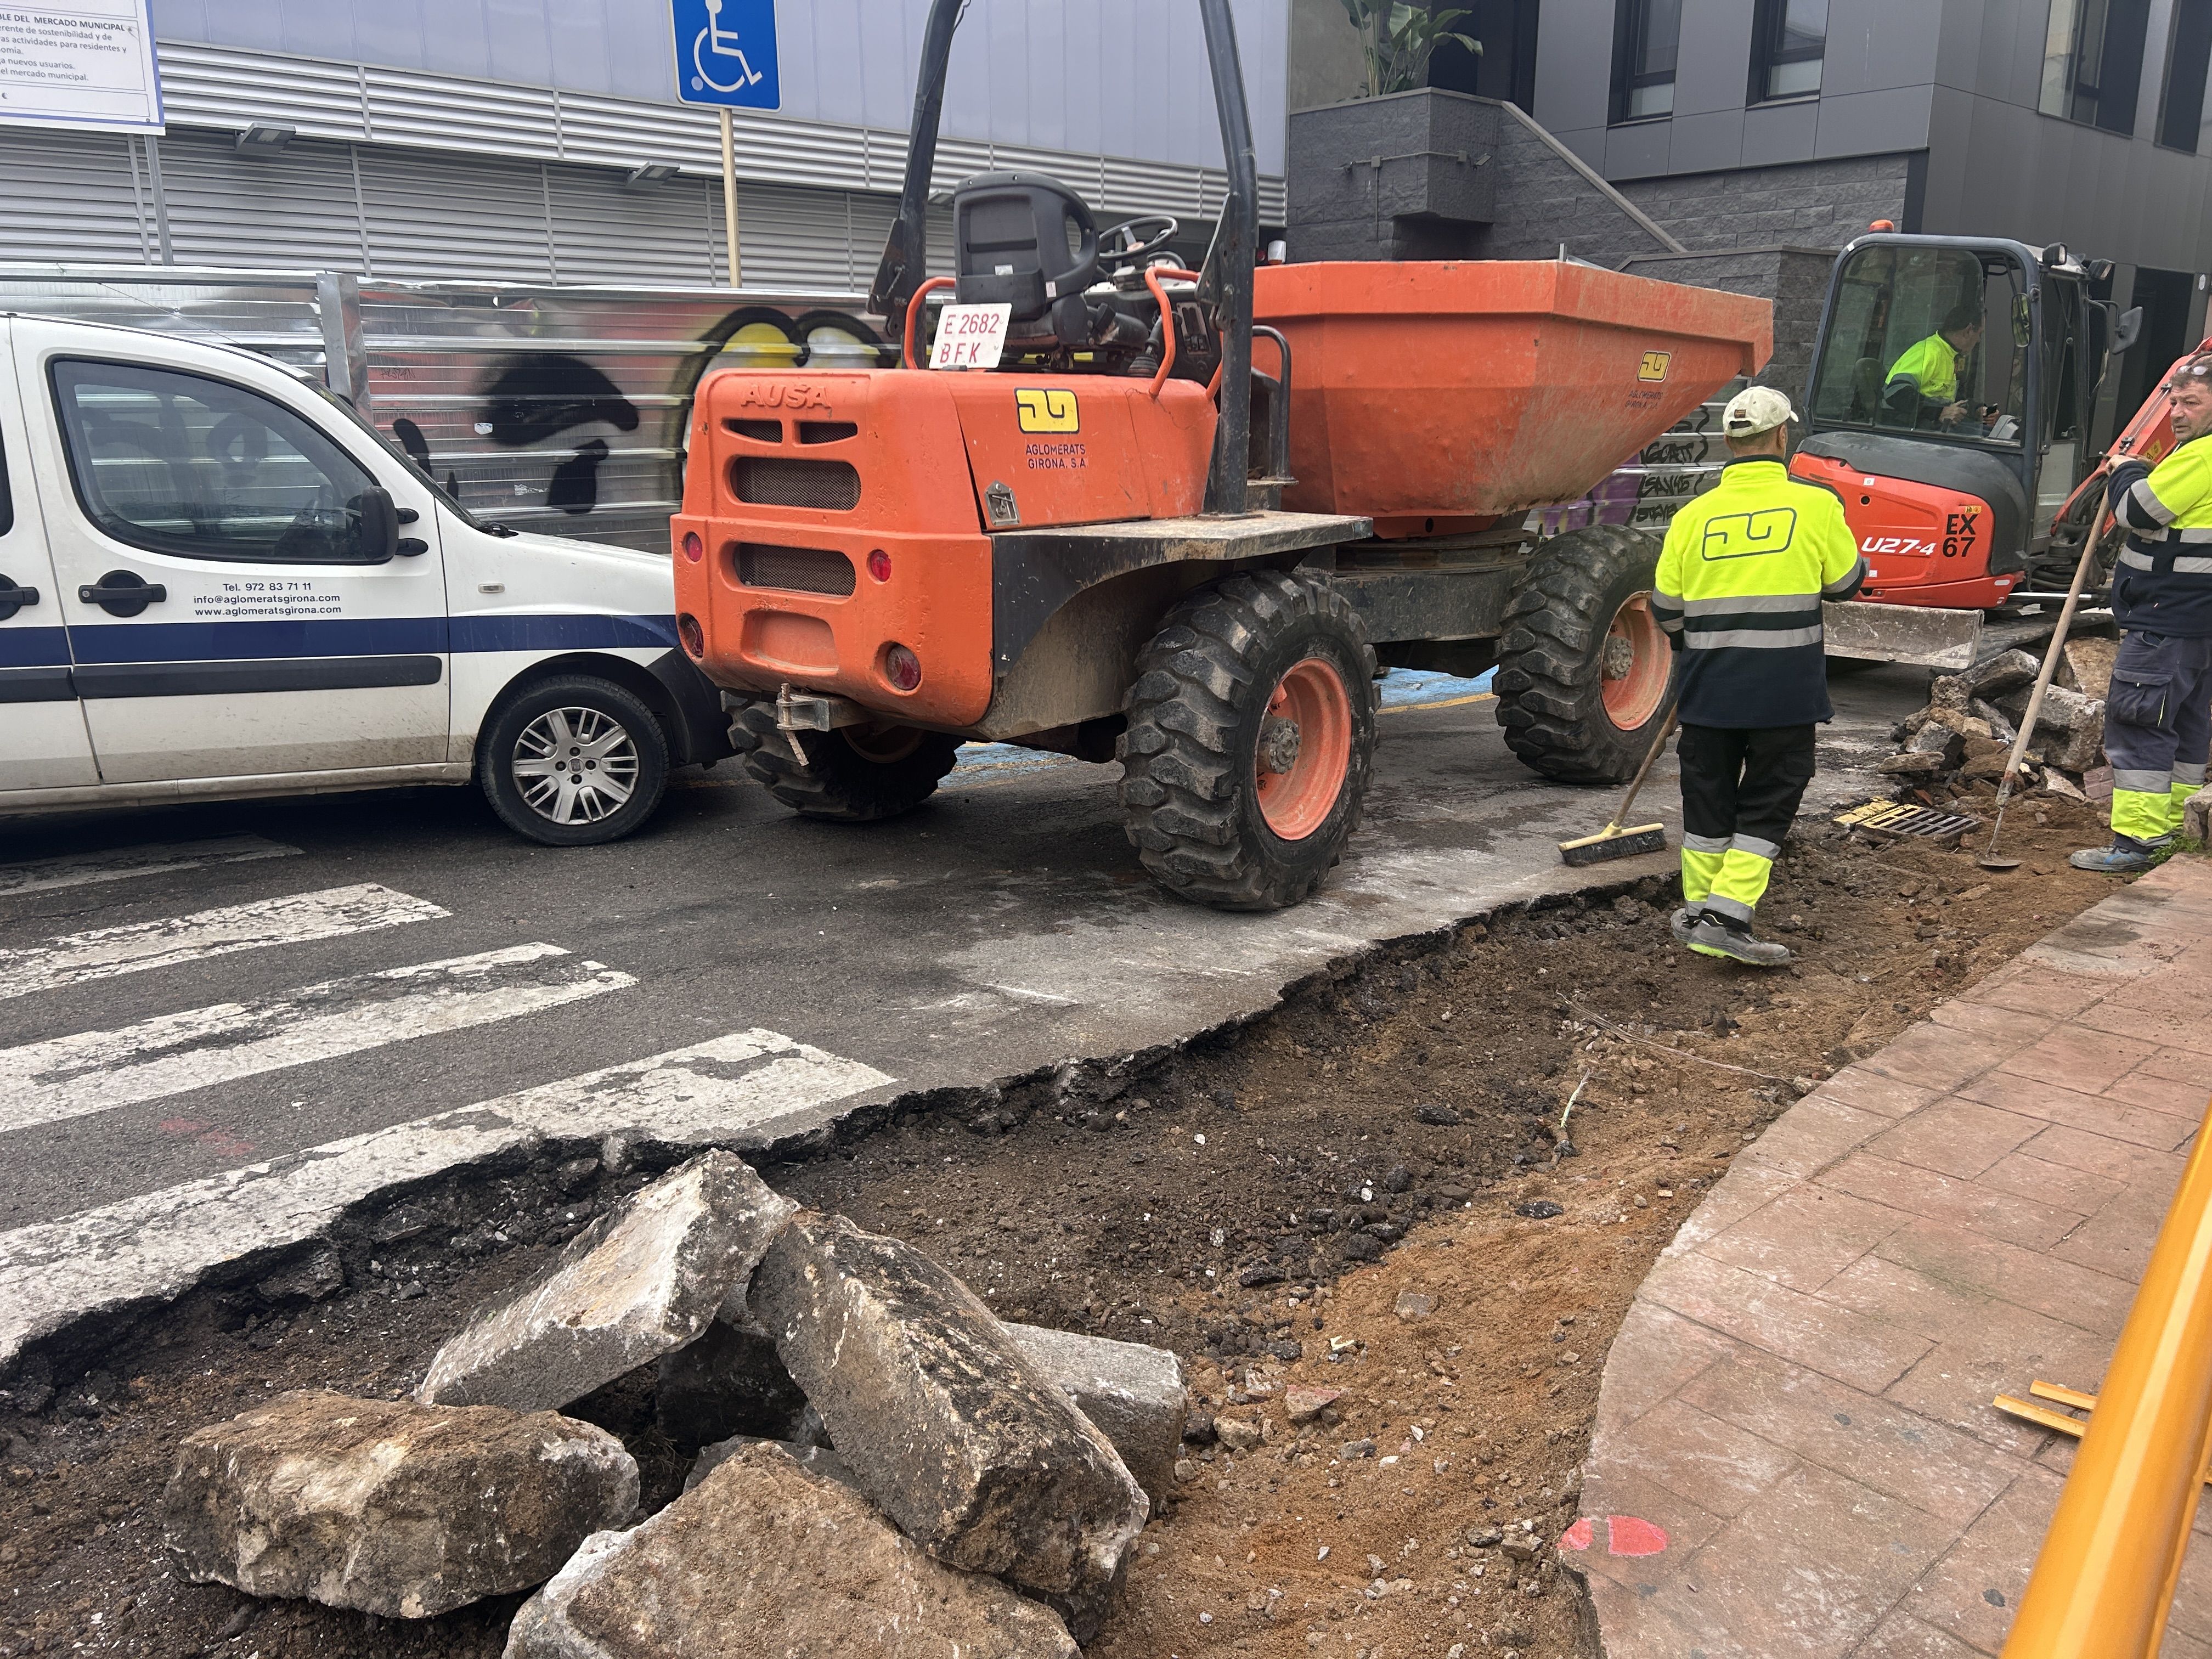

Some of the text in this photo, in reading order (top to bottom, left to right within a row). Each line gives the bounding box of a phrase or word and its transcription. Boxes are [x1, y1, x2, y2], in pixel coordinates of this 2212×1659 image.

[14, 14, 30, 22] DEL
[34, 16, 77, 26] MERCADO
[80, 20, 125, 31] MUNICIPAL
[26, 26, 36, 34] de
[38, 29, 93, 39] sostenibilidad
[12, 37, 58, 47] actividades
[80, 43, 120, 52] residentes
[40, 61, 75, 69] usuarios.
[10, 69, 46, 78] mercado
[48, 72, 89, 81] municipal.
[945, 313, 1000, 334] E 2682
[741, 384, 832, 409] AUSA
[1026, 443, 1086, 455] AGLOMERATS
[1946, 514, 1978, 535] EX
[1861, 537, 1937, 556] U27-4
[1942, 537, 1976, 557] 67
[223, 583, 241, 591] Tel.
[245, 583, 264, 591] 972
[269, 583, 283, 591] 83
[287, 583, 298, 591] 71
[194, 594, 340, 605] info@aglomeratsgirona.com
[195, 605, 341, 617] www.aglomeratsgirona.com
